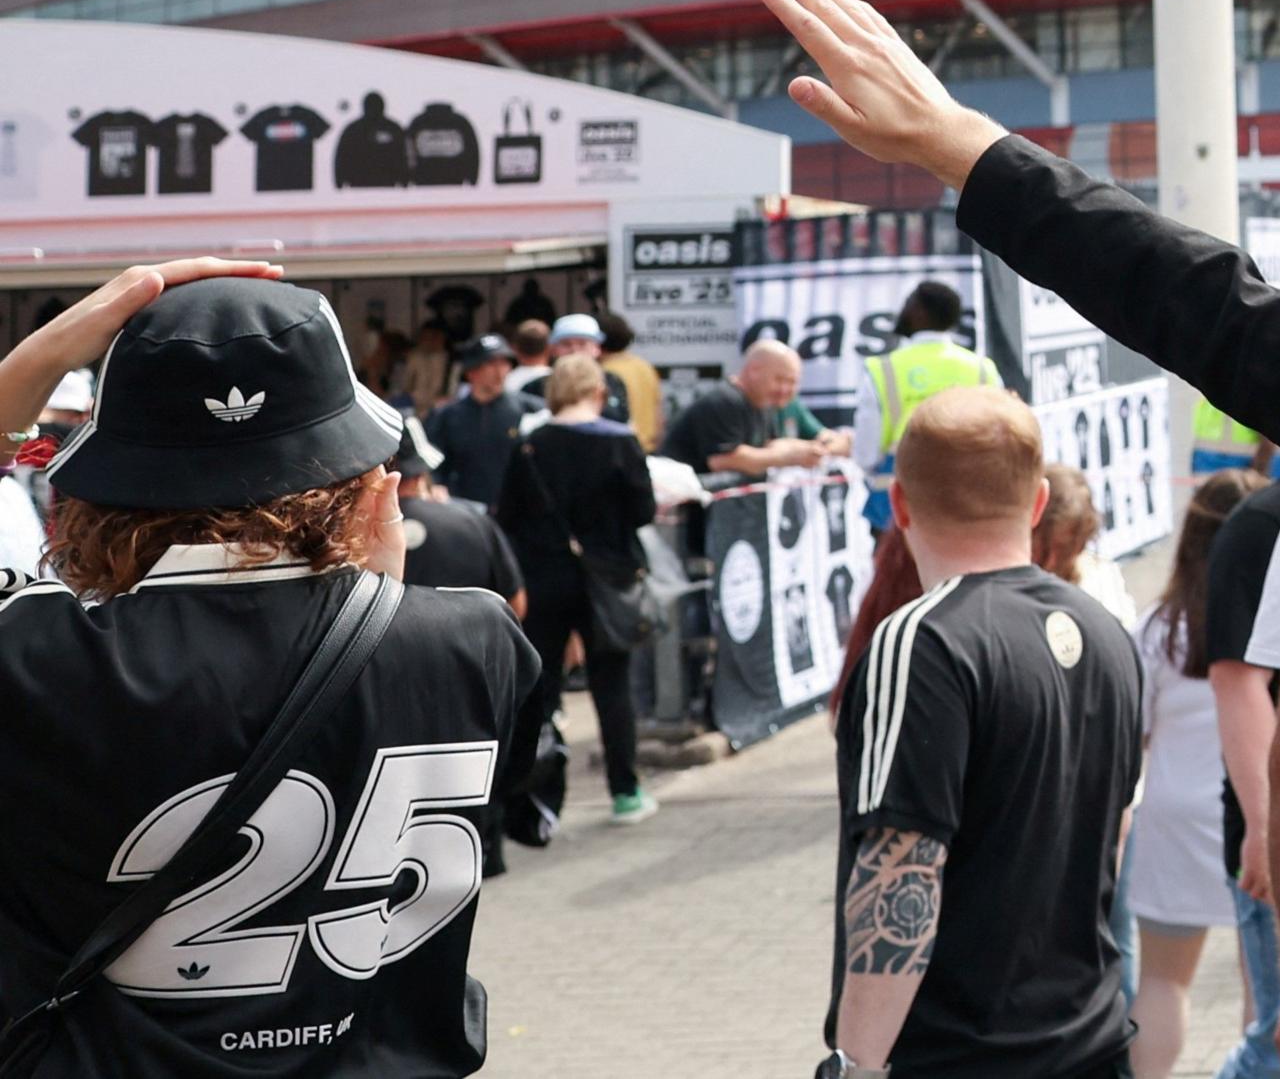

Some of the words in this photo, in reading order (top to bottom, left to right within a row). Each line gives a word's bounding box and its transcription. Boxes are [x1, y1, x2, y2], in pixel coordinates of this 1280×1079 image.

[634, 234, 731, 265] oasis
[635, 281, 682, 301] live
[690, 278, 732, 301] '25
[646, 316, 719, 328] OFFICIAL
[633, 332, 738, 345] ERCHANDISE
[104, 740, 499, 999] 25
[220, 1023, 333, 1051] CARDIFF,
